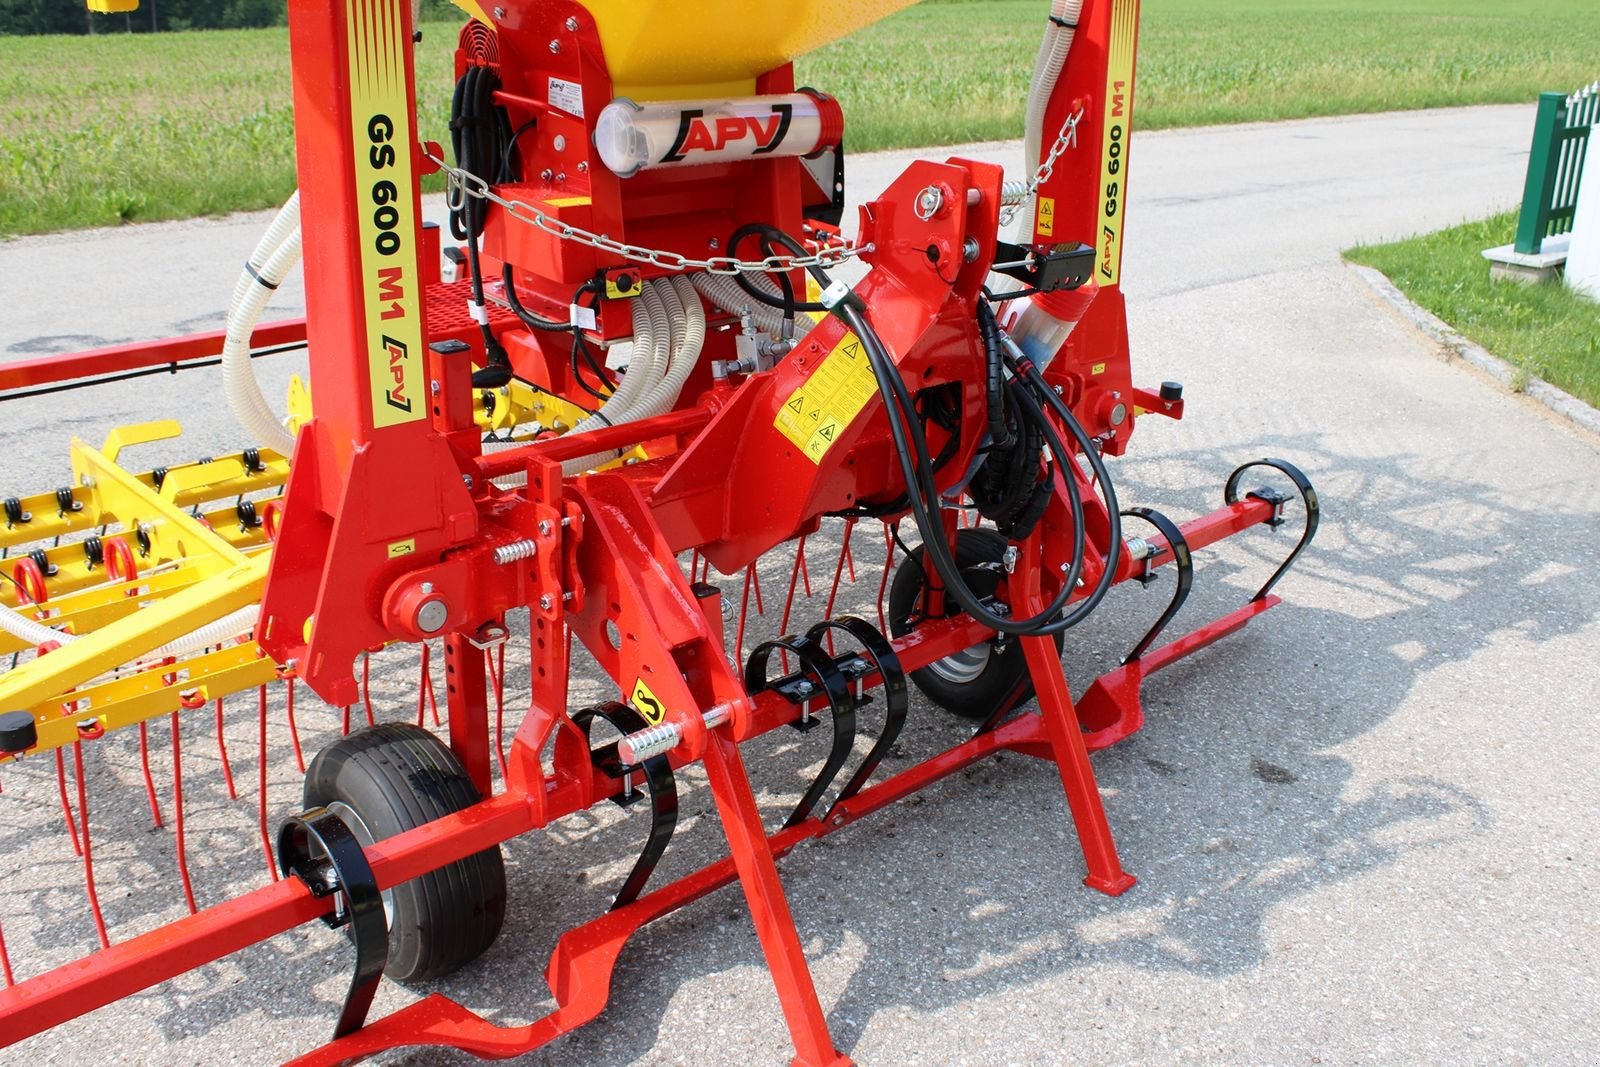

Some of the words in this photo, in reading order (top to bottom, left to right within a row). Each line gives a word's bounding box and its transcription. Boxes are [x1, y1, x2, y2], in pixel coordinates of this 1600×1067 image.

[1112, 81, 1125, 117] M1
[368, 114, 395, 170] GS
[677, 114, 782, 155] APV
[1108, 125, 1121, 175] 600
[372, 180, 400, 256] 600
[1105, 182, 1118, 217] GS
[378, 267, 405, 320] M1
[387, 345, 406, 403] APV
